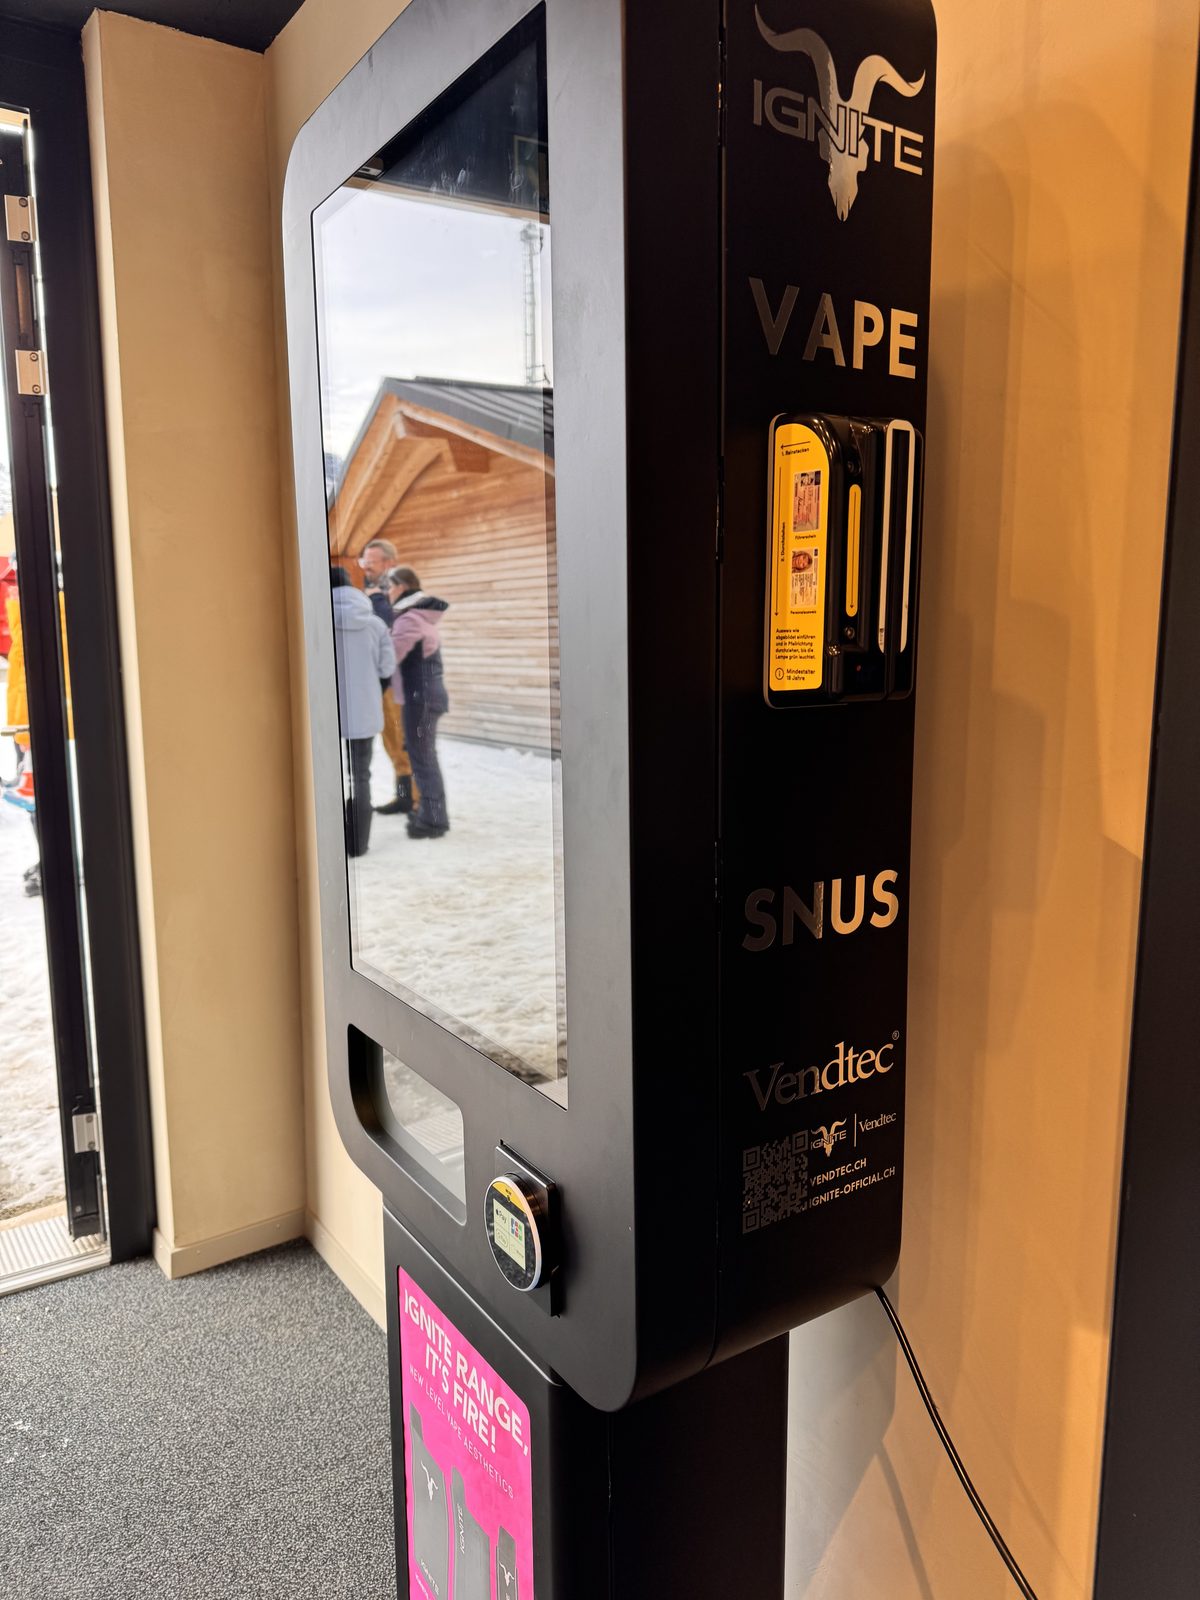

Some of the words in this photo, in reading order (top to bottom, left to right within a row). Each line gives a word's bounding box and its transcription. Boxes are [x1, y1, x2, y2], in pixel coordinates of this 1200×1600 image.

[753, 79, 924, 175] IGNITE
[748, 276, 918, 379] VAPE
[742, 869, 899, 951] SNUS
[810, 1129, 847, 1151] IGNITE
[859, 1112, 897, 1133] Vendtec
[809, 1166, 896, 1209] IGNITE-OFFICIAL.CH
[810, 1157, 867, 1188] VENDTEC.CH
[404, 1288, 453, 1368] IGNITE
[456, 1350, 529, 1457] RANGE,
[425, 1343, 450, 1395] IT'S
[453, 1380, 496, 1454] FIRE!
[409, 1364, 424, 1386] NEW
[426, 1383, 445, 1415] LEVEL
[446, 1411, 462, 1441] VAPE
[463, 1435, 514, 1499] AESTHETICS
